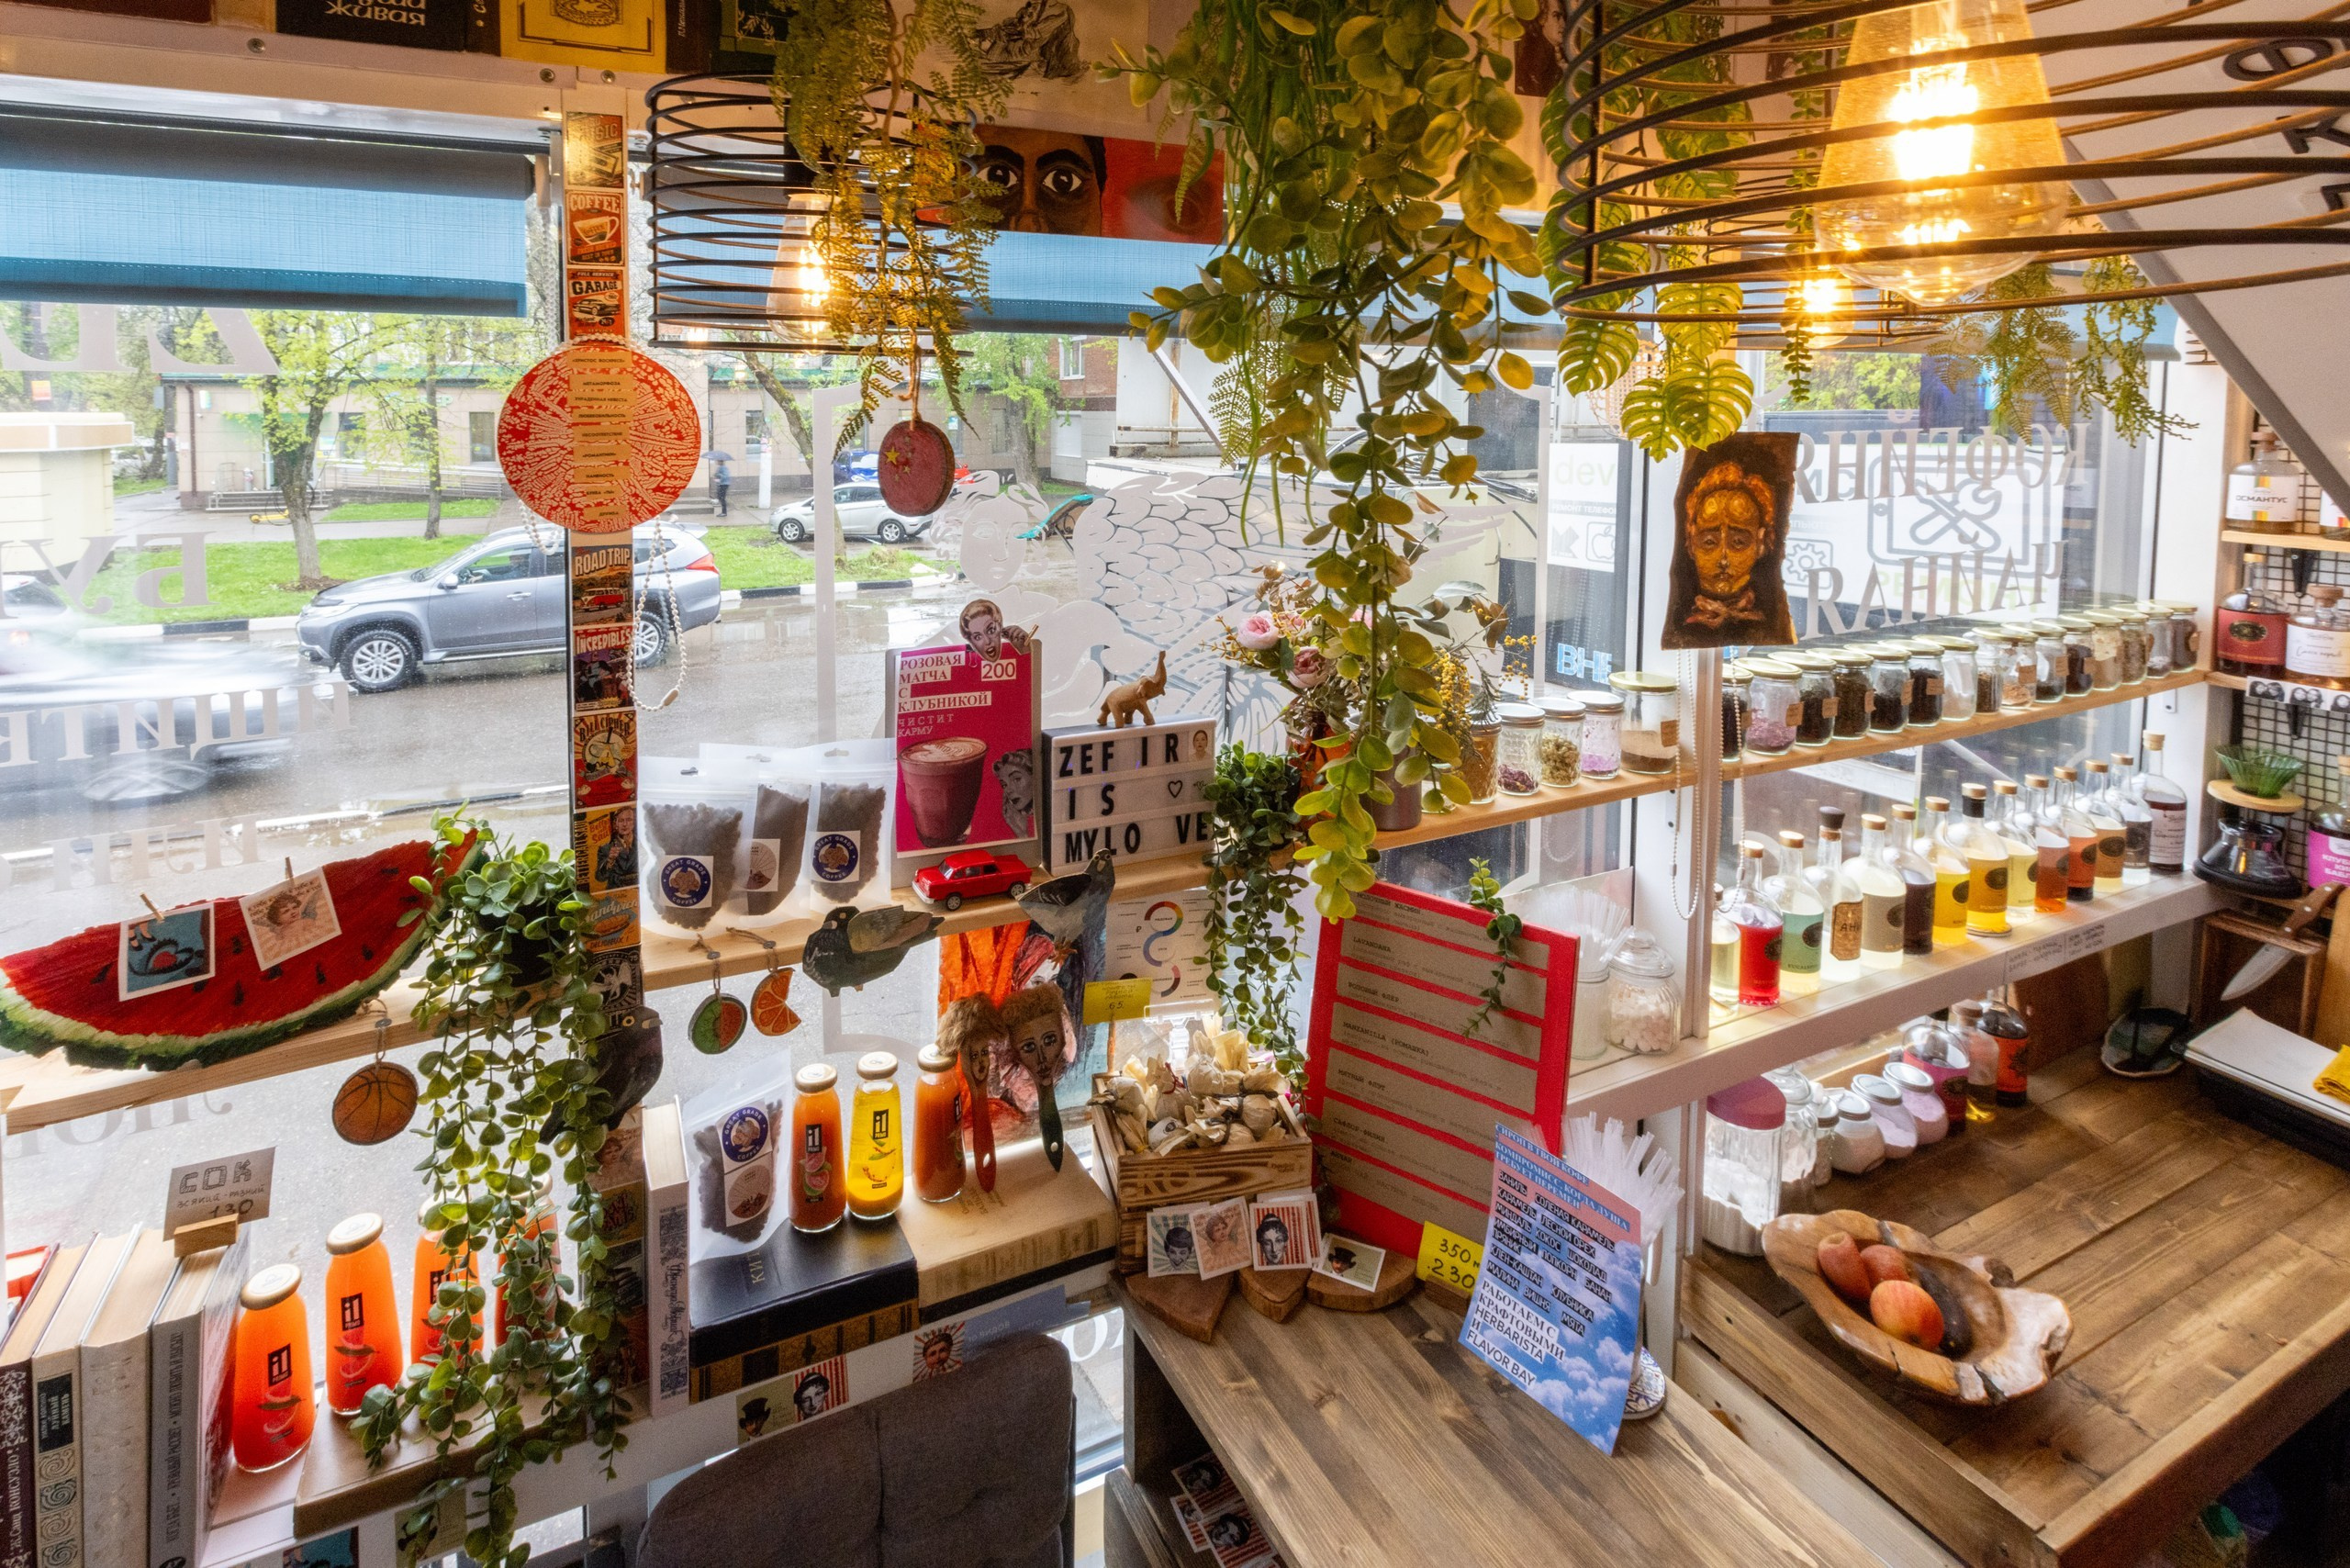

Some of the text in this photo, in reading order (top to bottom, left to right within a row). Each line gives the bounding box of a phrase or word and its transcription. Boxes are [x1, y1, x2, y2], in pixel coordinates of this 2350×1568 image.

[570, 194, 621, 214] COFFEE
[571, 281, 619, 296] GARAGE
[2235, 495, 2288, 504] ОСМАНТУС
[575, 547, 631, 577] ROAD TRIP
[576, 628, 632, 655] INCREDIBLES
[899, 669, 948, 684] МАТЧА
[901, 654, 962, 670] РОЗОВАЯ
[981, 662, 1015, 679] 200
[898, 688, 908, 699] С
[898, 691, 989, 712] КЛУБНИКОЙ
[898, 725, 934, 737] КАРМУ
[665, 858, 706, 877] GREAT GRADE
[822, 871, 847, 880] COFFEE
[671, 896, 698, 906] COFFEE
[724, 1108, 762, 1136] GREAT GRADE
[1495, 1123, 1526, 1148] СИРОП
[1534, 1145, 1561, 1168] ТВОЙ
[1561, 1160, 1589, 1186] КОФЕ
[179, 1159, 252, 1194] СОК
[1496, 1150, 1533, 1181] ТРЕБУЕТ
[1534, 1172, 1580, 1210] ПЕРЕМЕН
[1498, 1170, 1527, 1195] ВАНИЛЬ
[1498, 1187, 1537, 1219] КАРАМЕЛЬ
[1564, 1183, 1595, 1210] КОГДА
[1595, 1204, 1628, 1232] ДУША
[1535, 1193, 1616, 1251] СОЛЕНАЯ КАРАМЕЛЬ
[1438, 1238, 1472, 1263] 350
[1493, 1230, 1522, 1255] ПРЯНИК
[1496, 1203, 1607, 1283] МИНДАЛЬ КОКОС ШОКОЛАД
[1541, 1215, 1596, 1259] ЛЕСНОЙ ОРЕХ
[1494, 1217, 1613, 1304] ИМБИРНЫЙ ПОПКОРН БАНАН
[1491, 1245, 1595, 1321] КЛЕН-КАШТАН КЛУБНИКА
[1482, 1280, 1556, 1338] РАБОТАЕМ С
[1486, 1260, 1585, 1336] МАЛИНА ВИШНЯ МЯТА
[1472, 1317, 1481, 1331] И
[1474, 1304, 1543, 1362] HERBARISTA
[1479, 1293, 1564, 1361] КРАФТОВЫМИ
[1467, 1330, 1536, 1386] FLAVOR BAY
[60, 1392, 71, 1426] КАМЕНЬ
[8, 1453, 21, 1513] КОНСУЭЛО
